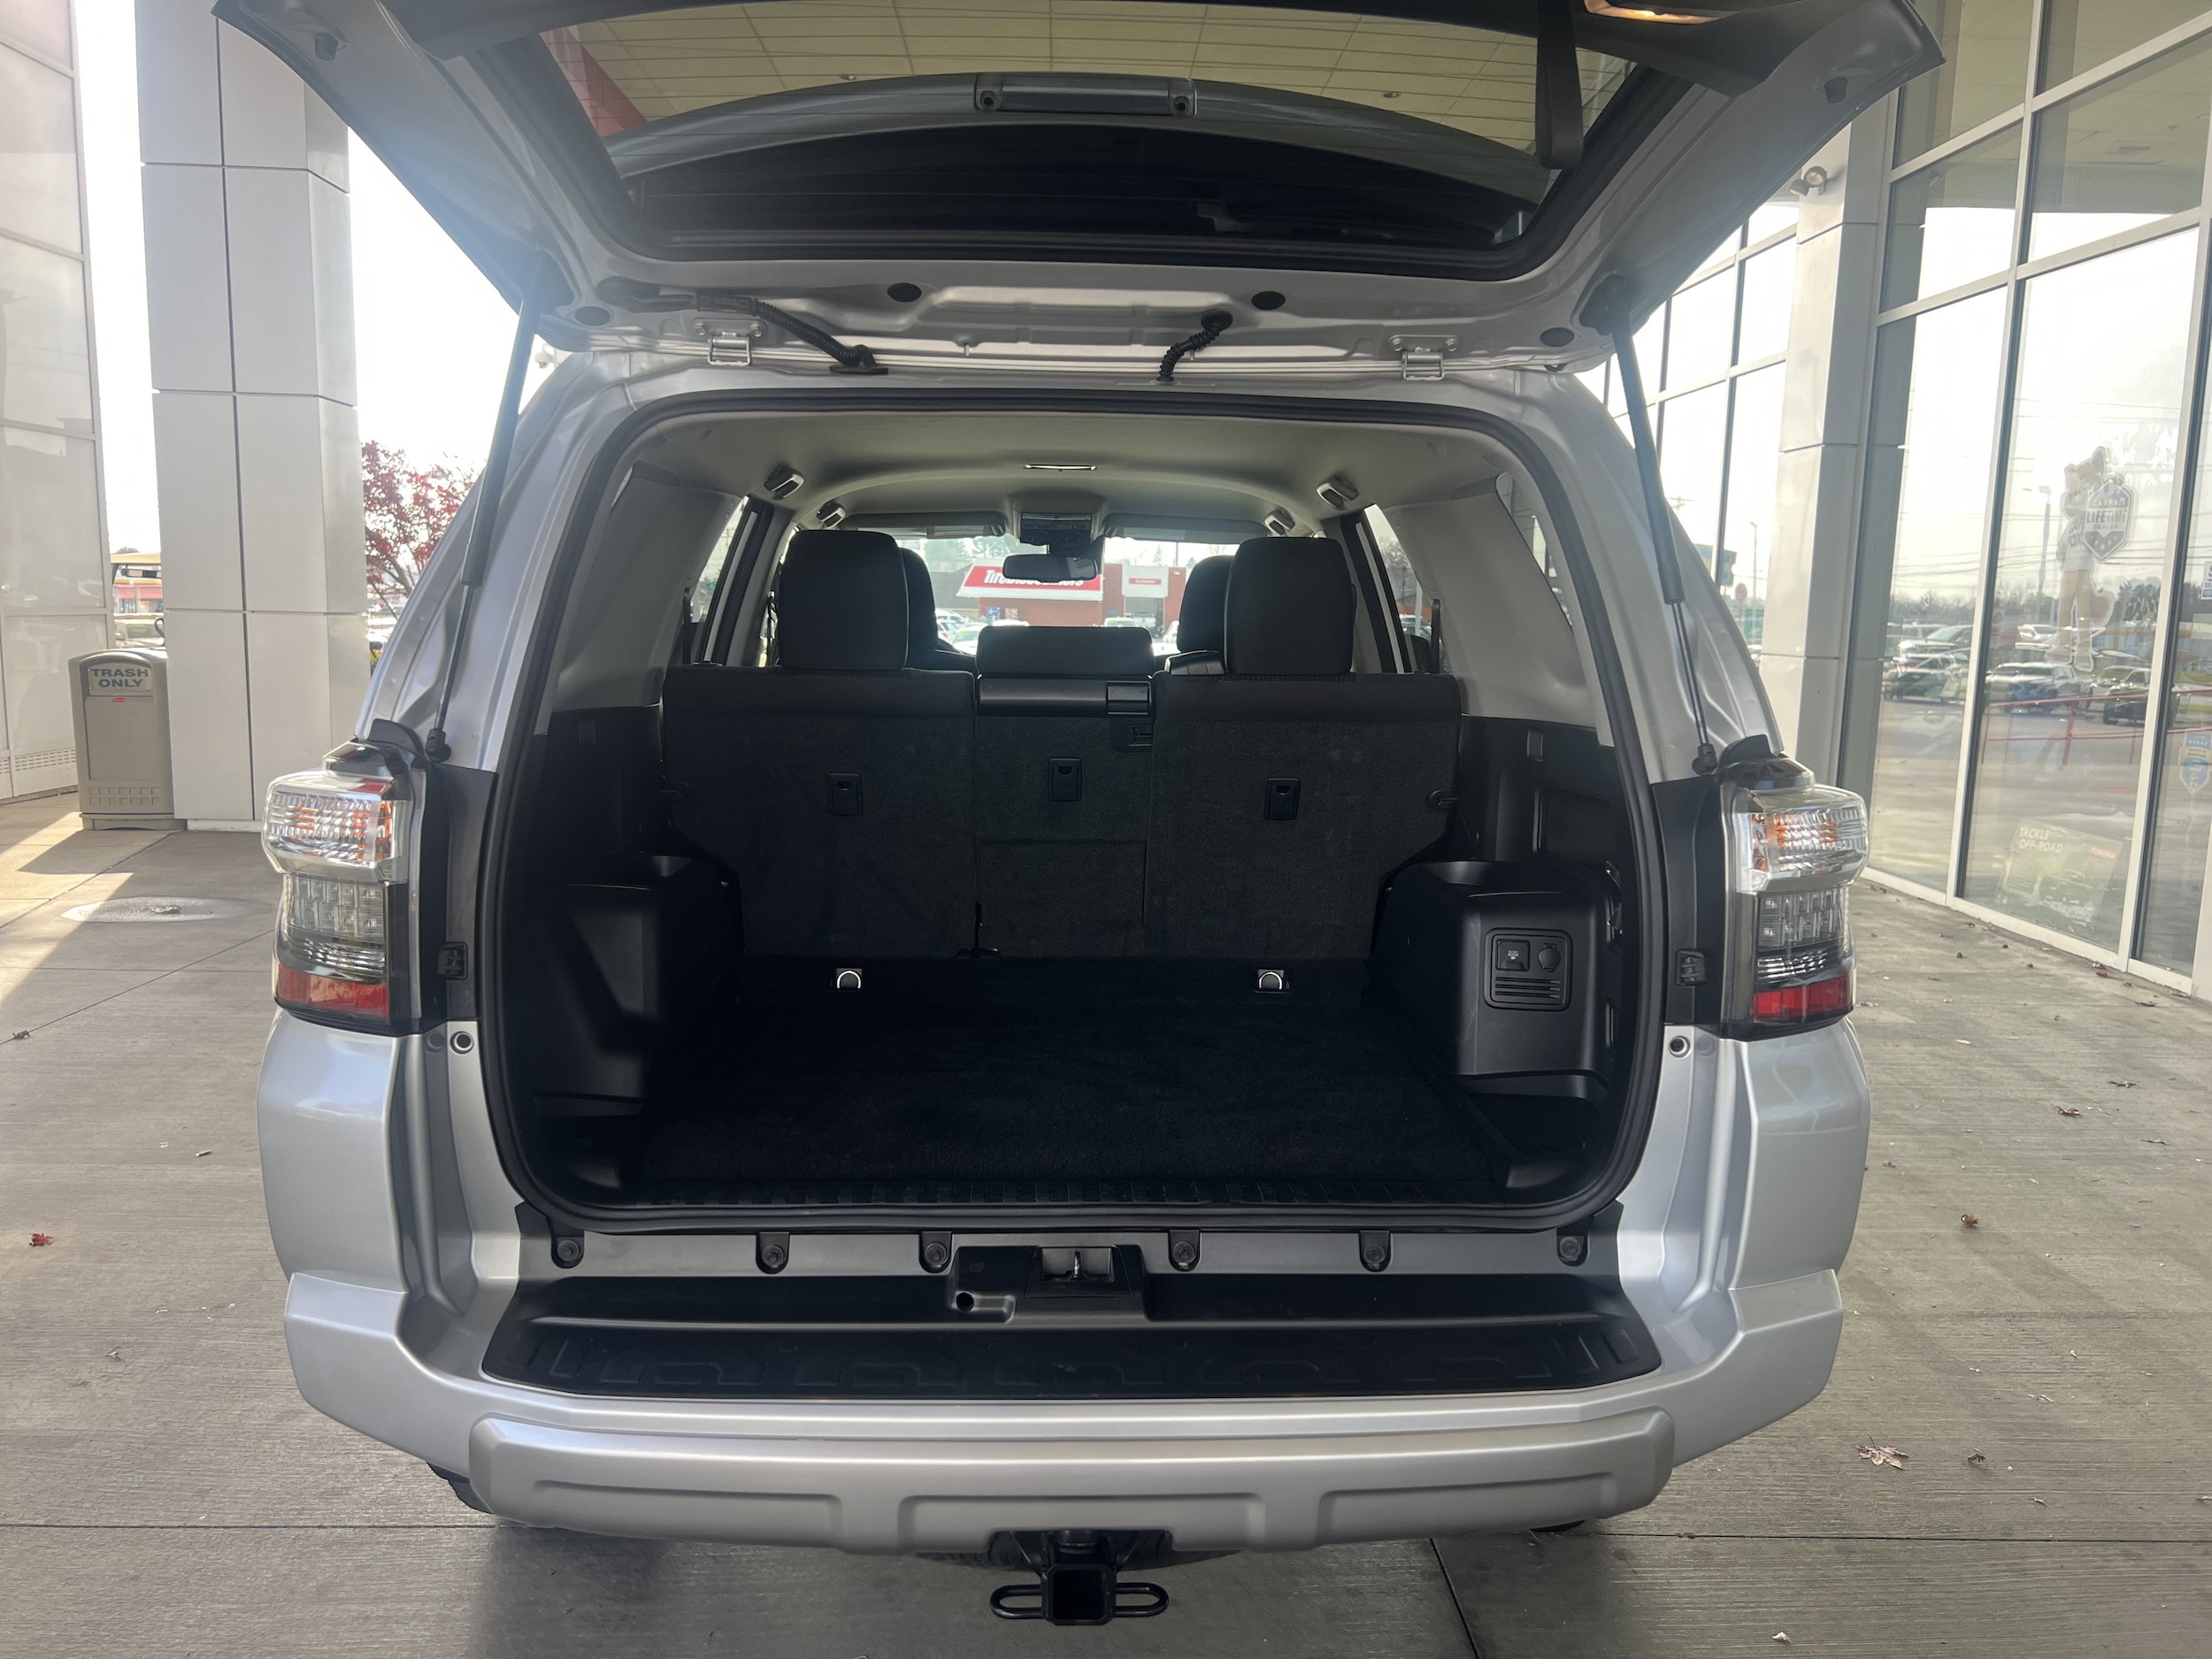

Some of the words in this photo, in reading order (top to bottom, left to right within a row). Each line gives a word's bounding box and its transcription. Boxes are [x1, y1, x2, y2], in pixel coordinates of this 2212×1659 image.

[2086, 510, 2127, 523] LIFETIME
[90, 668, 150, 677] TRASH
[98, 679, 143, 687] ONLY
[2019, 827, 2050, 841] TACKLE
[2019, 839, 2062, 853] OFF-ROAD
